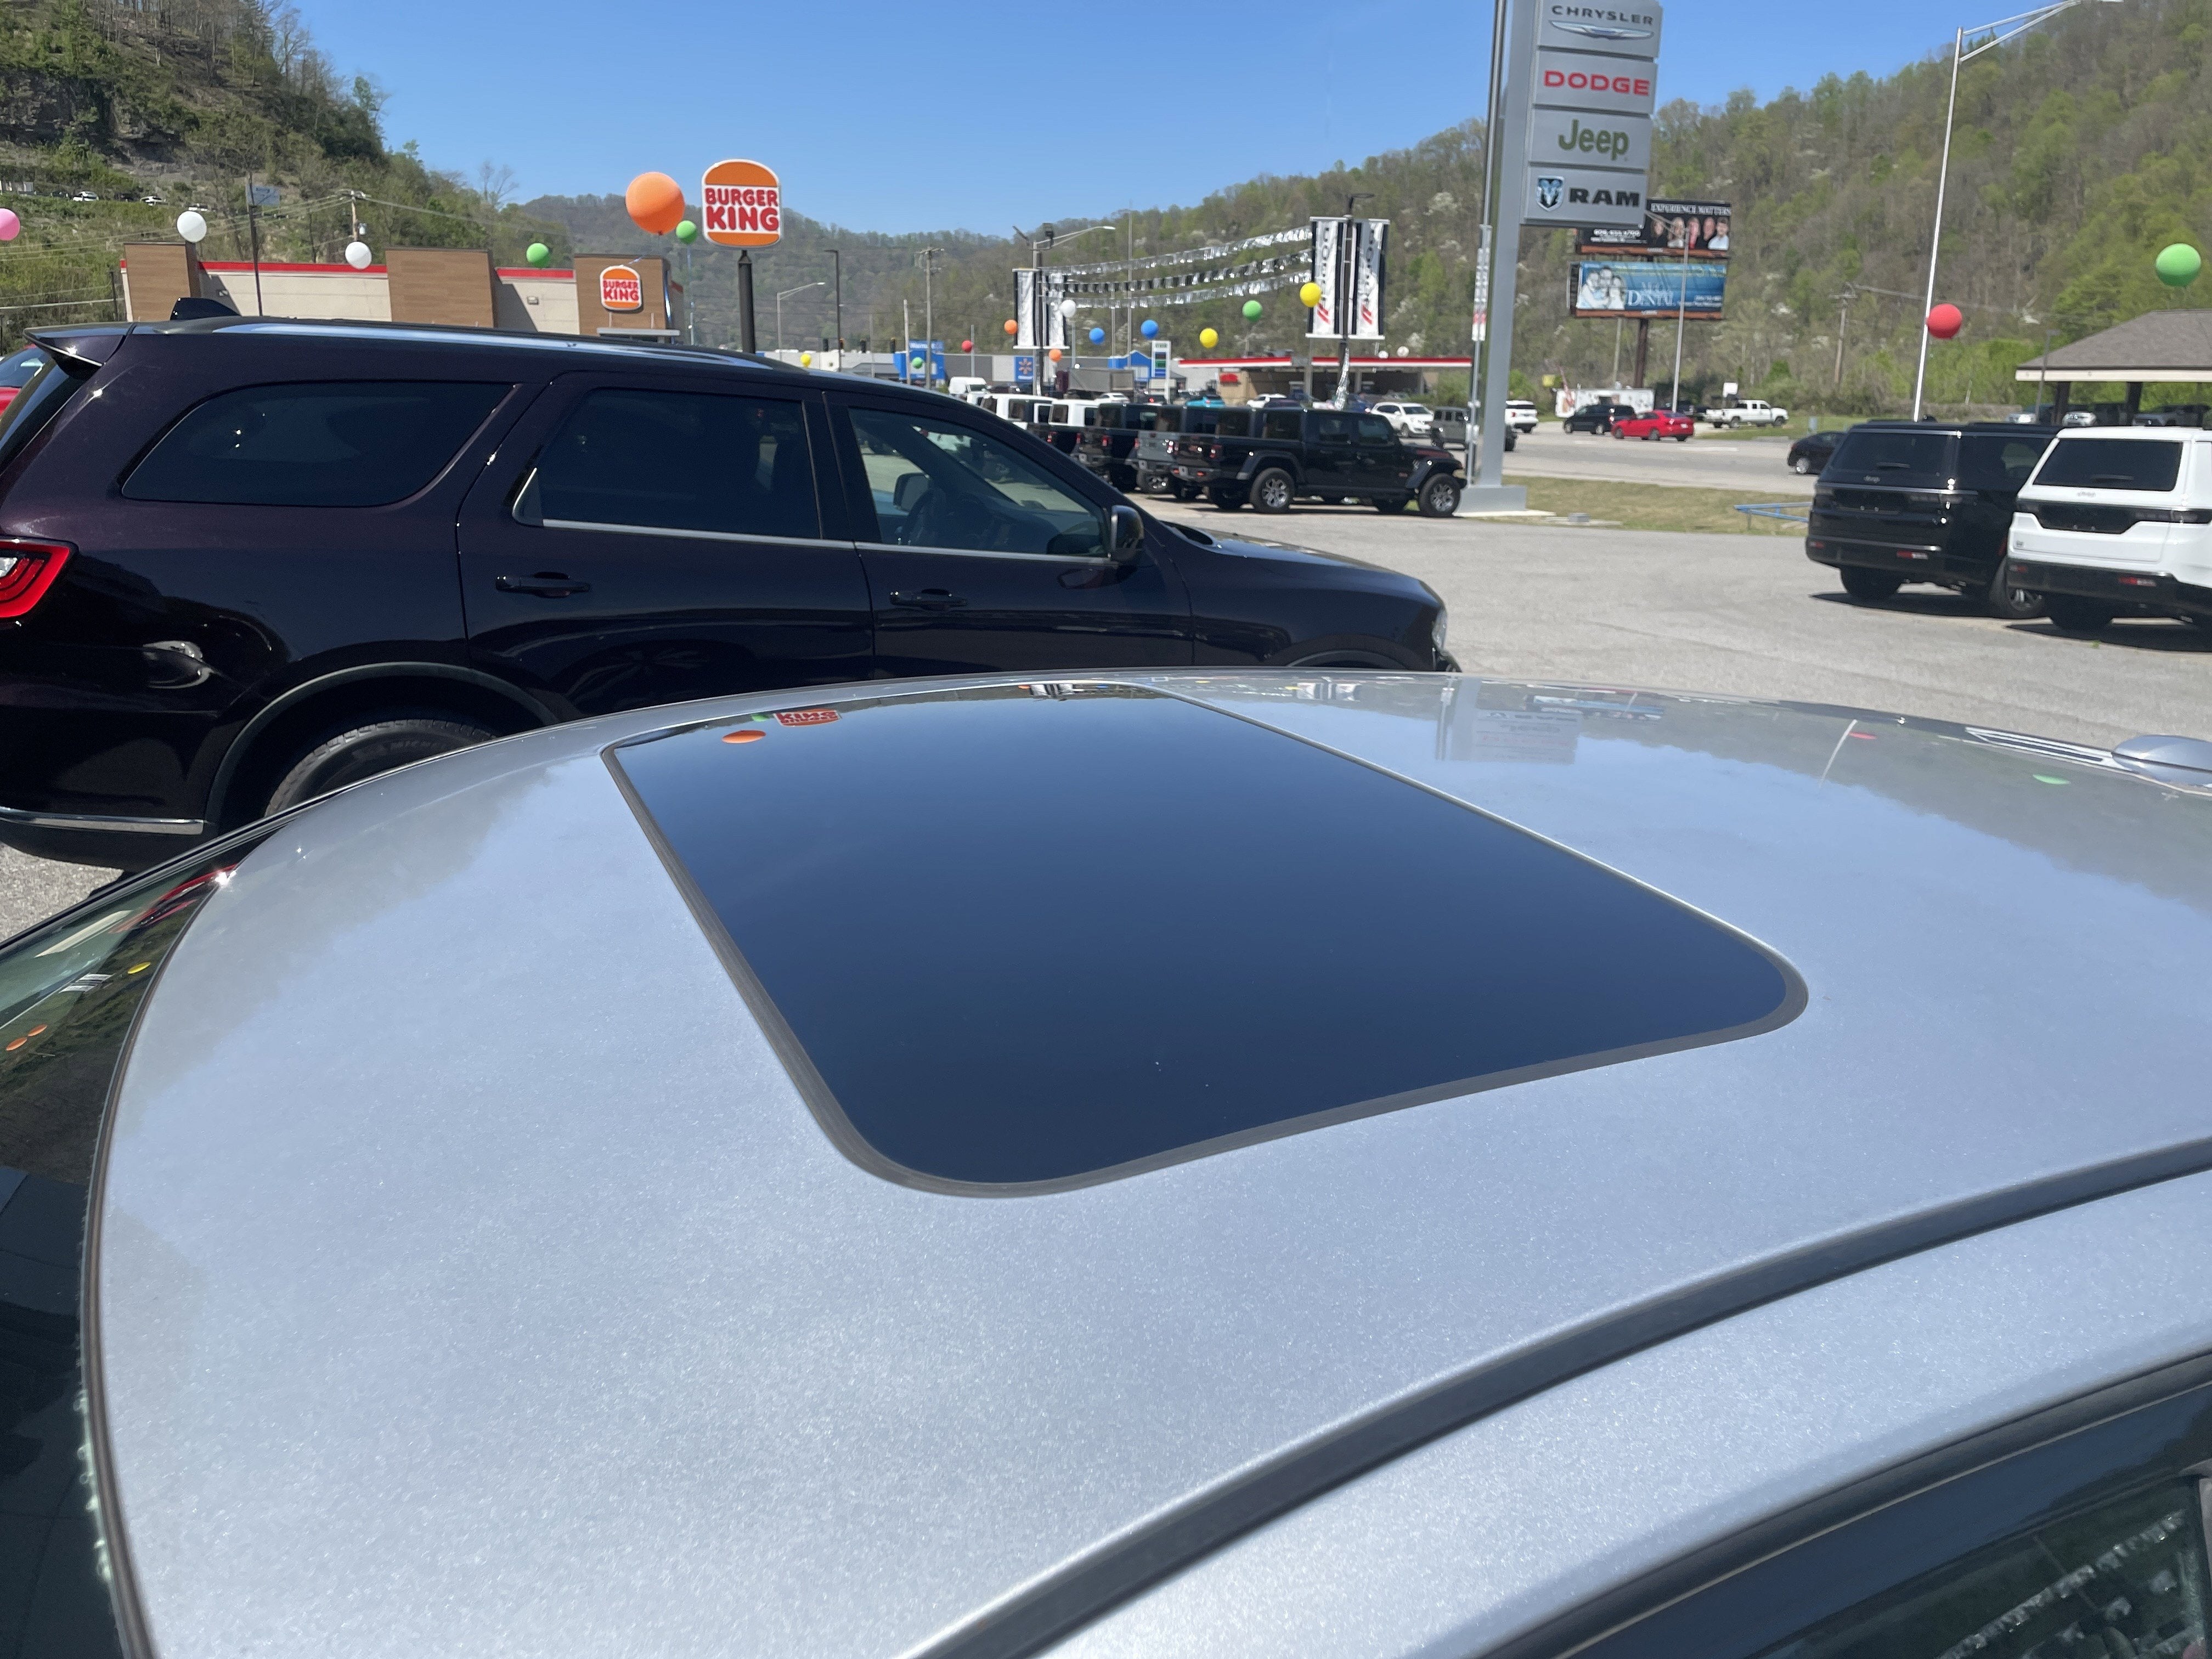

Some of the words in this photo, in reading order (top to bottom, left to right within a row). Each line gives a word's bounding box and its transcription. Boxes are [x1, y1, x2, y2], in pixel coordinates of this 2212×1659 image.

[1551, 5, 1654, 25] CHRYSLER
[1544, 70, 1650, 96] DODGE
[1558, 119, 1629, 161] Jeep
[705, 188, 778, 207] BURGER
[1569, 187, 1640, 207] RAM
[706, 206, 779, 230] KING
[603, 280, 639, 289] BURGER
[604, 289, 639, 301] KING
